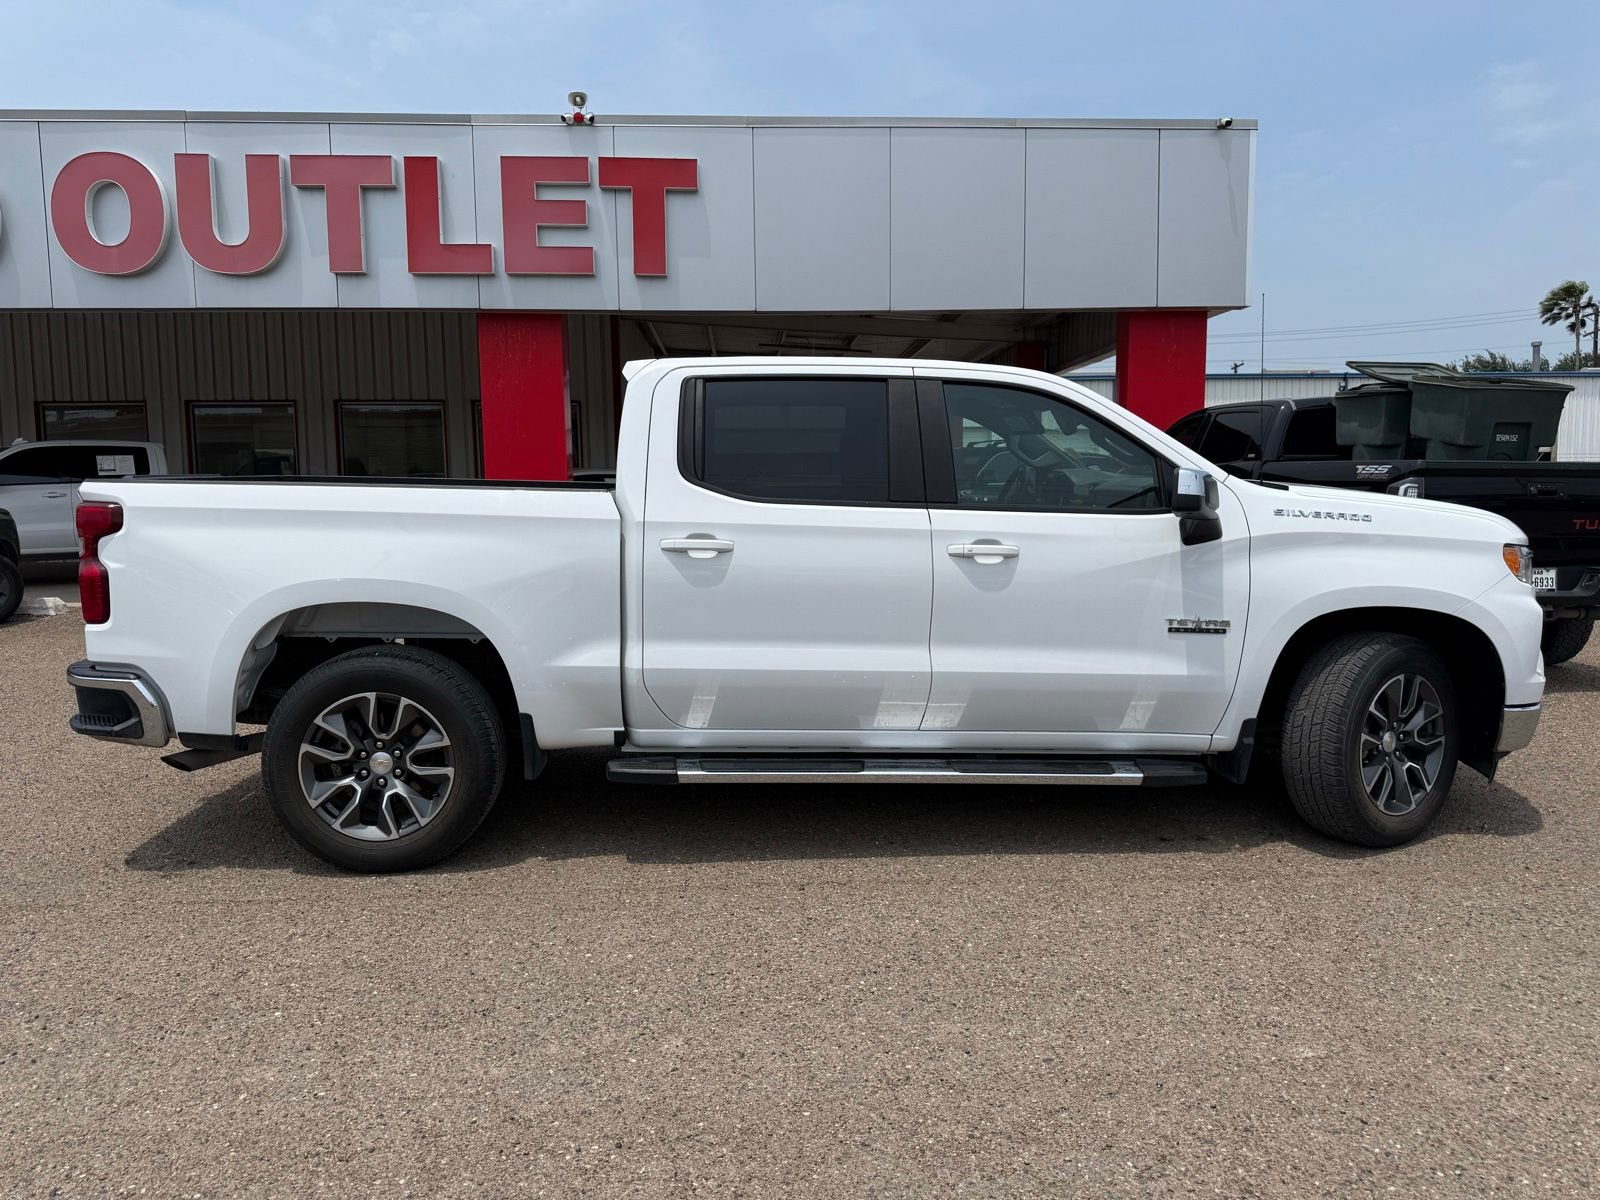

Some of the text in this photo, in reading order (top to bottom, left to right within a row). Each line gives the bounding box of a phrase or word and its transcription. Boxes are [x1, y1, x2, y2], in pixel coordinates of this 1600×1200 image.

[51, 151, 699, 277] OUTLET
[1355, 464, 1394, 474] TSS
[1273, 508, 1373, 523] SILVERADO
[1572, 518, 1600, 530] TU
[1165, 614, 1231, 628] TEXAS
